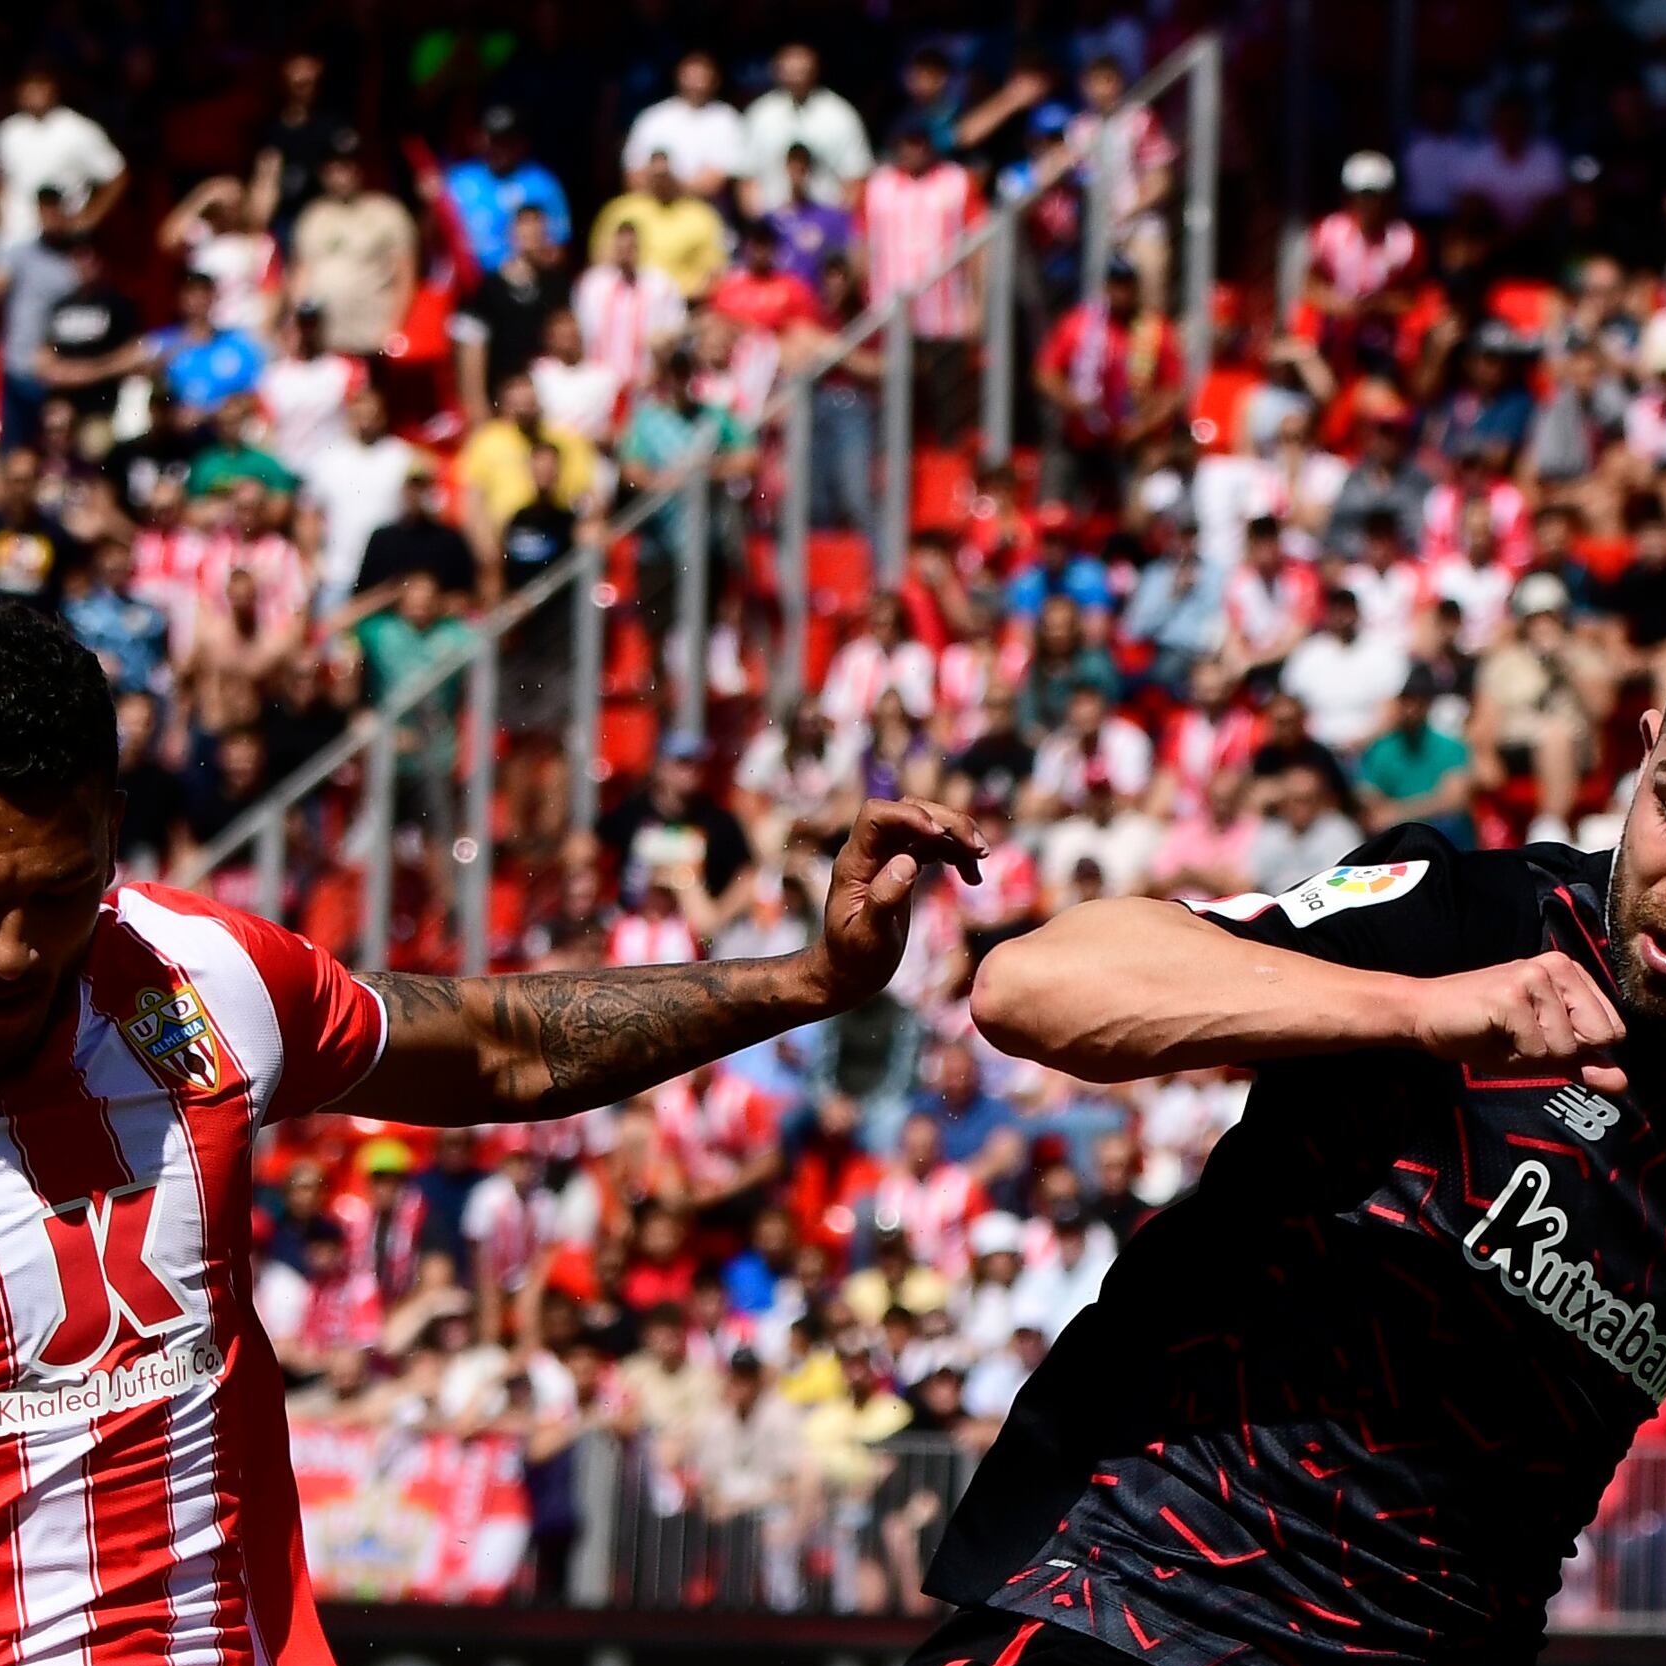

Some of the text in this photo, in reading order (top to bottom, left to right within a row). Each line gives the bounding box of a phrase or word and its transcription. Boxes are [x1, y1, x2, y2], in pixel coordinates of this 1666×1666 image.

[134, 1000, 189, 1037] U D
[114, 1356, 187, 1402] Juffali
[193, 1350, 219, 1375] Co.
